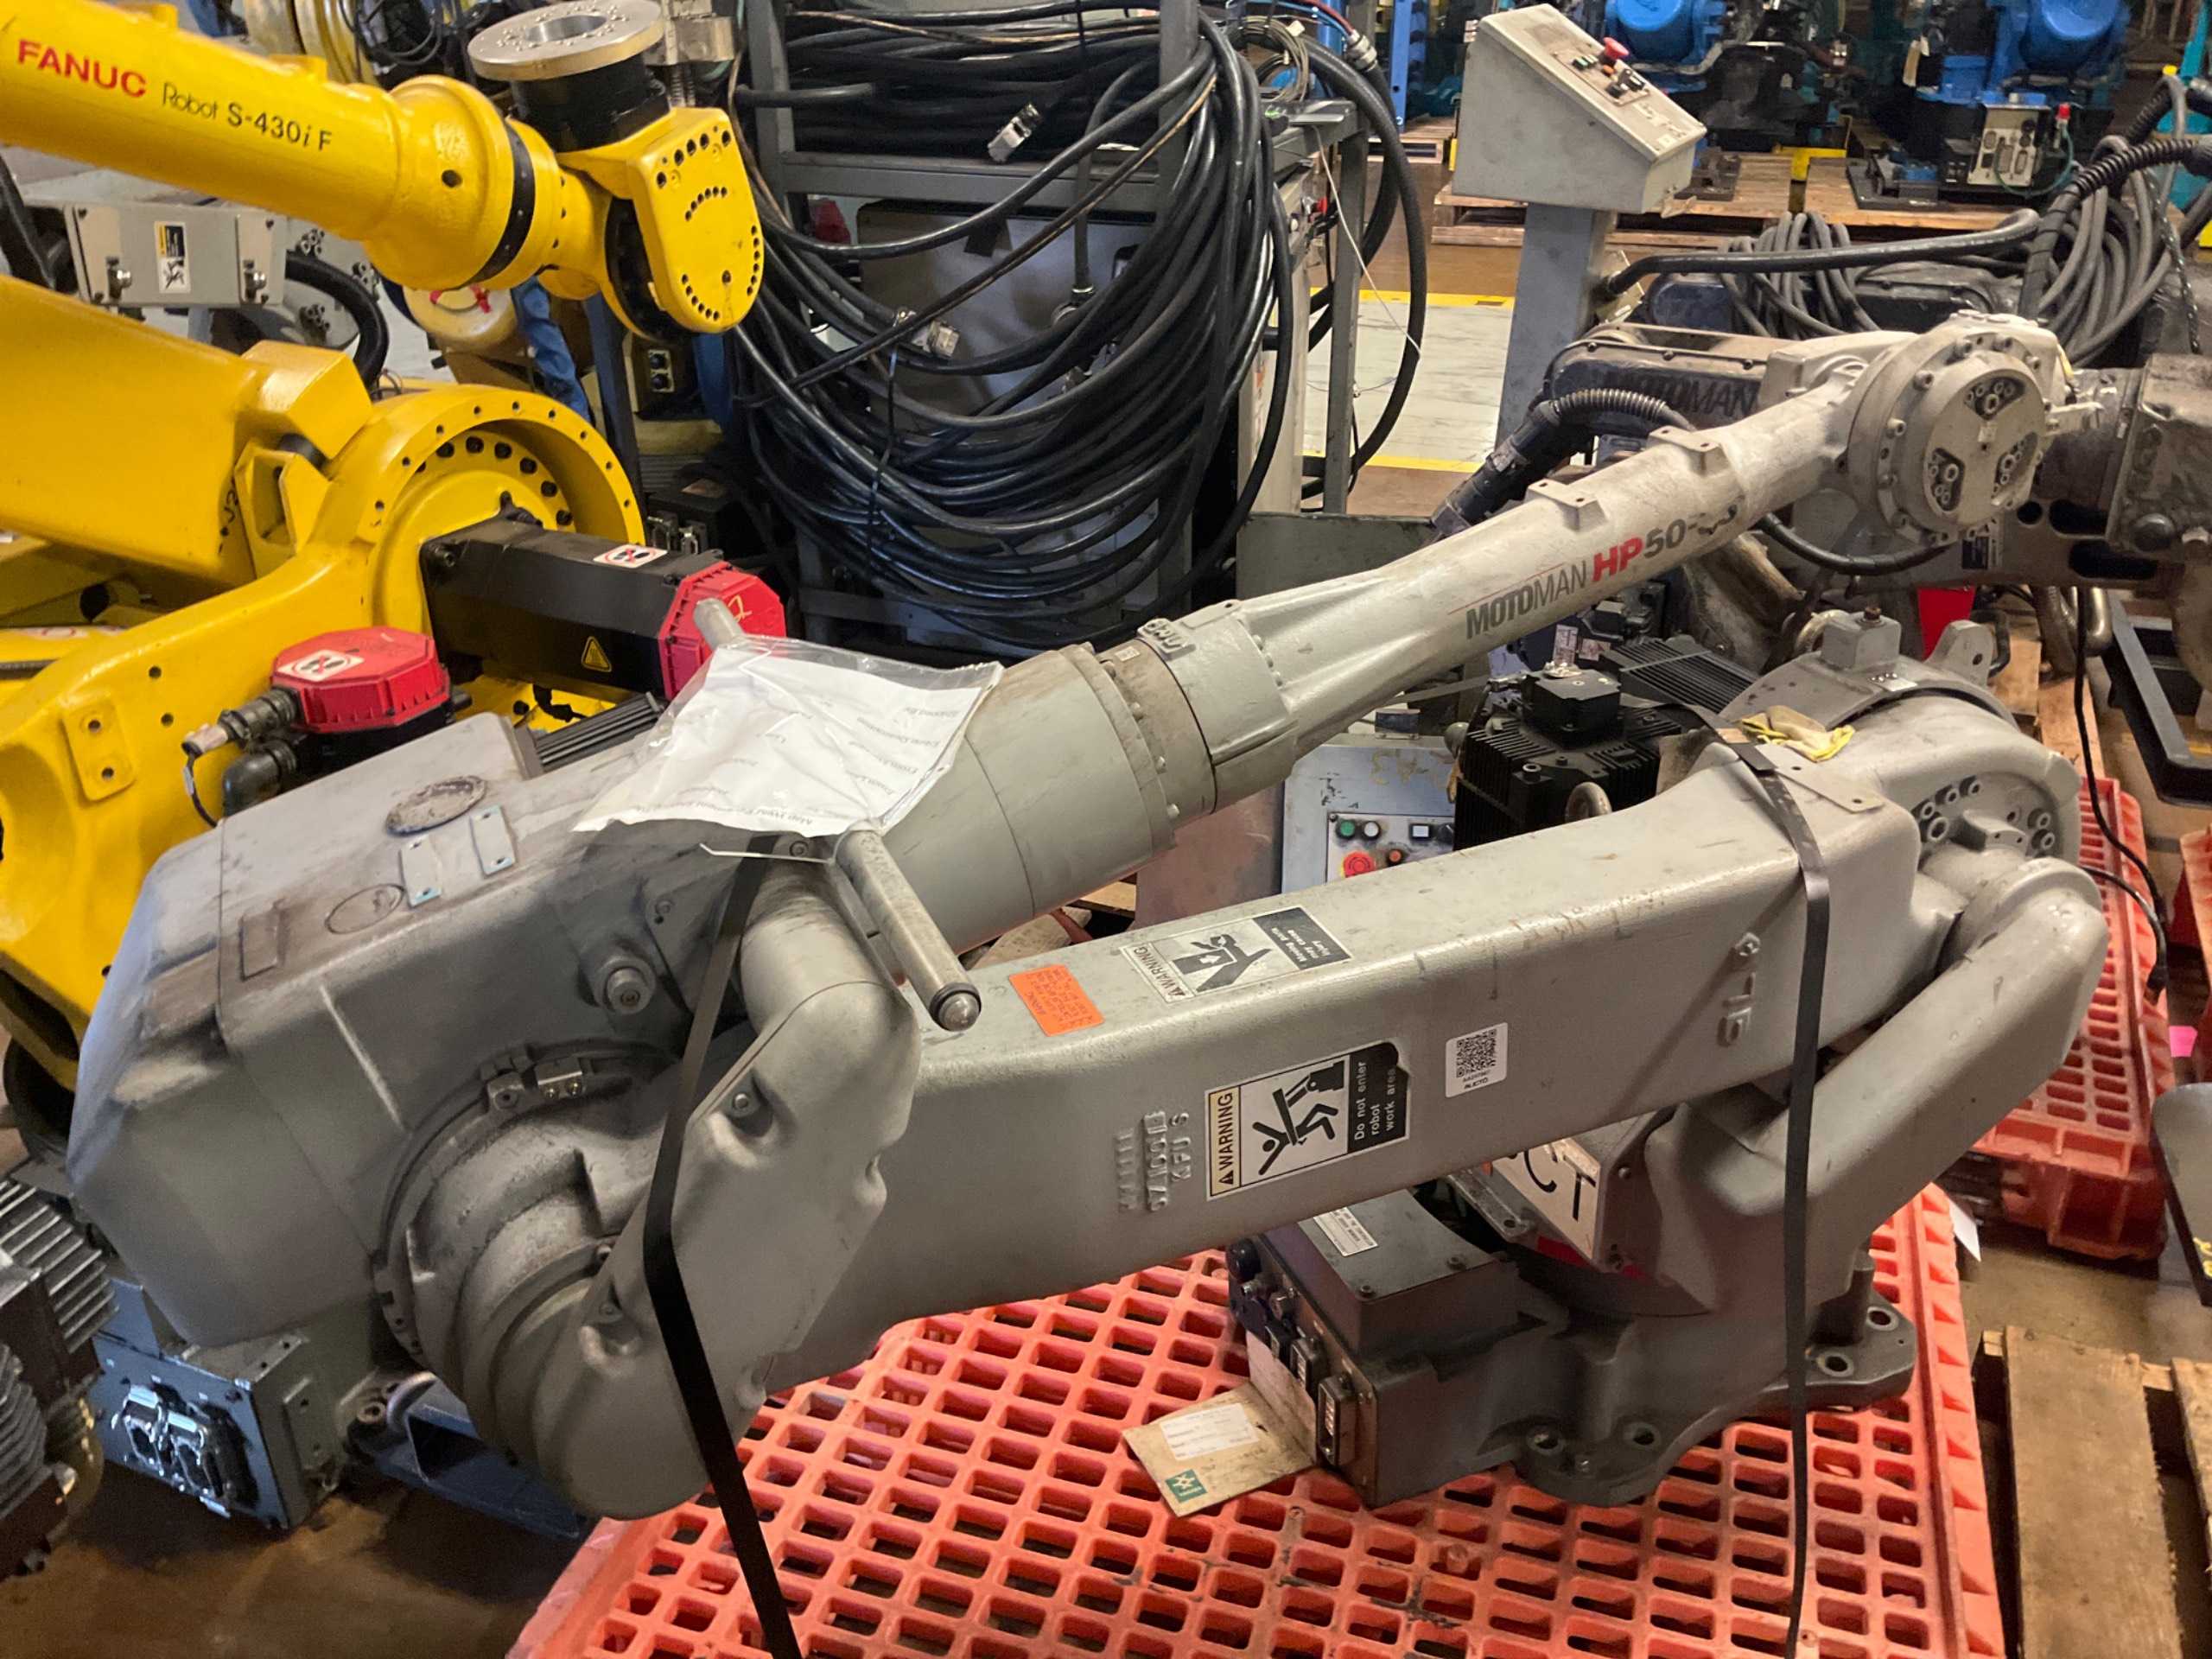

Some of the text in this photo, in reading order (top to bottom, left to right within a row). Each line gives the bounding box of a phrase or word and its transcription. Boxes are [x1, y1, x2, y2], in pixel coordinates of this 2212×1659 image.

[17, 39, 147, 98] FANUC
[162, 82, 218, 119] Robot
[1466, 560, 1587, 640] MOTOMAN
[1134, 946, 1176, 989] WARNING
[1217, 1092, 1234, 1171] WARNING
[1354, 1061, 1367, 1141] Do not enter
[1370, 1103, 1381, 1135] robot
[1384, 1067, 1396, 1131] work area
